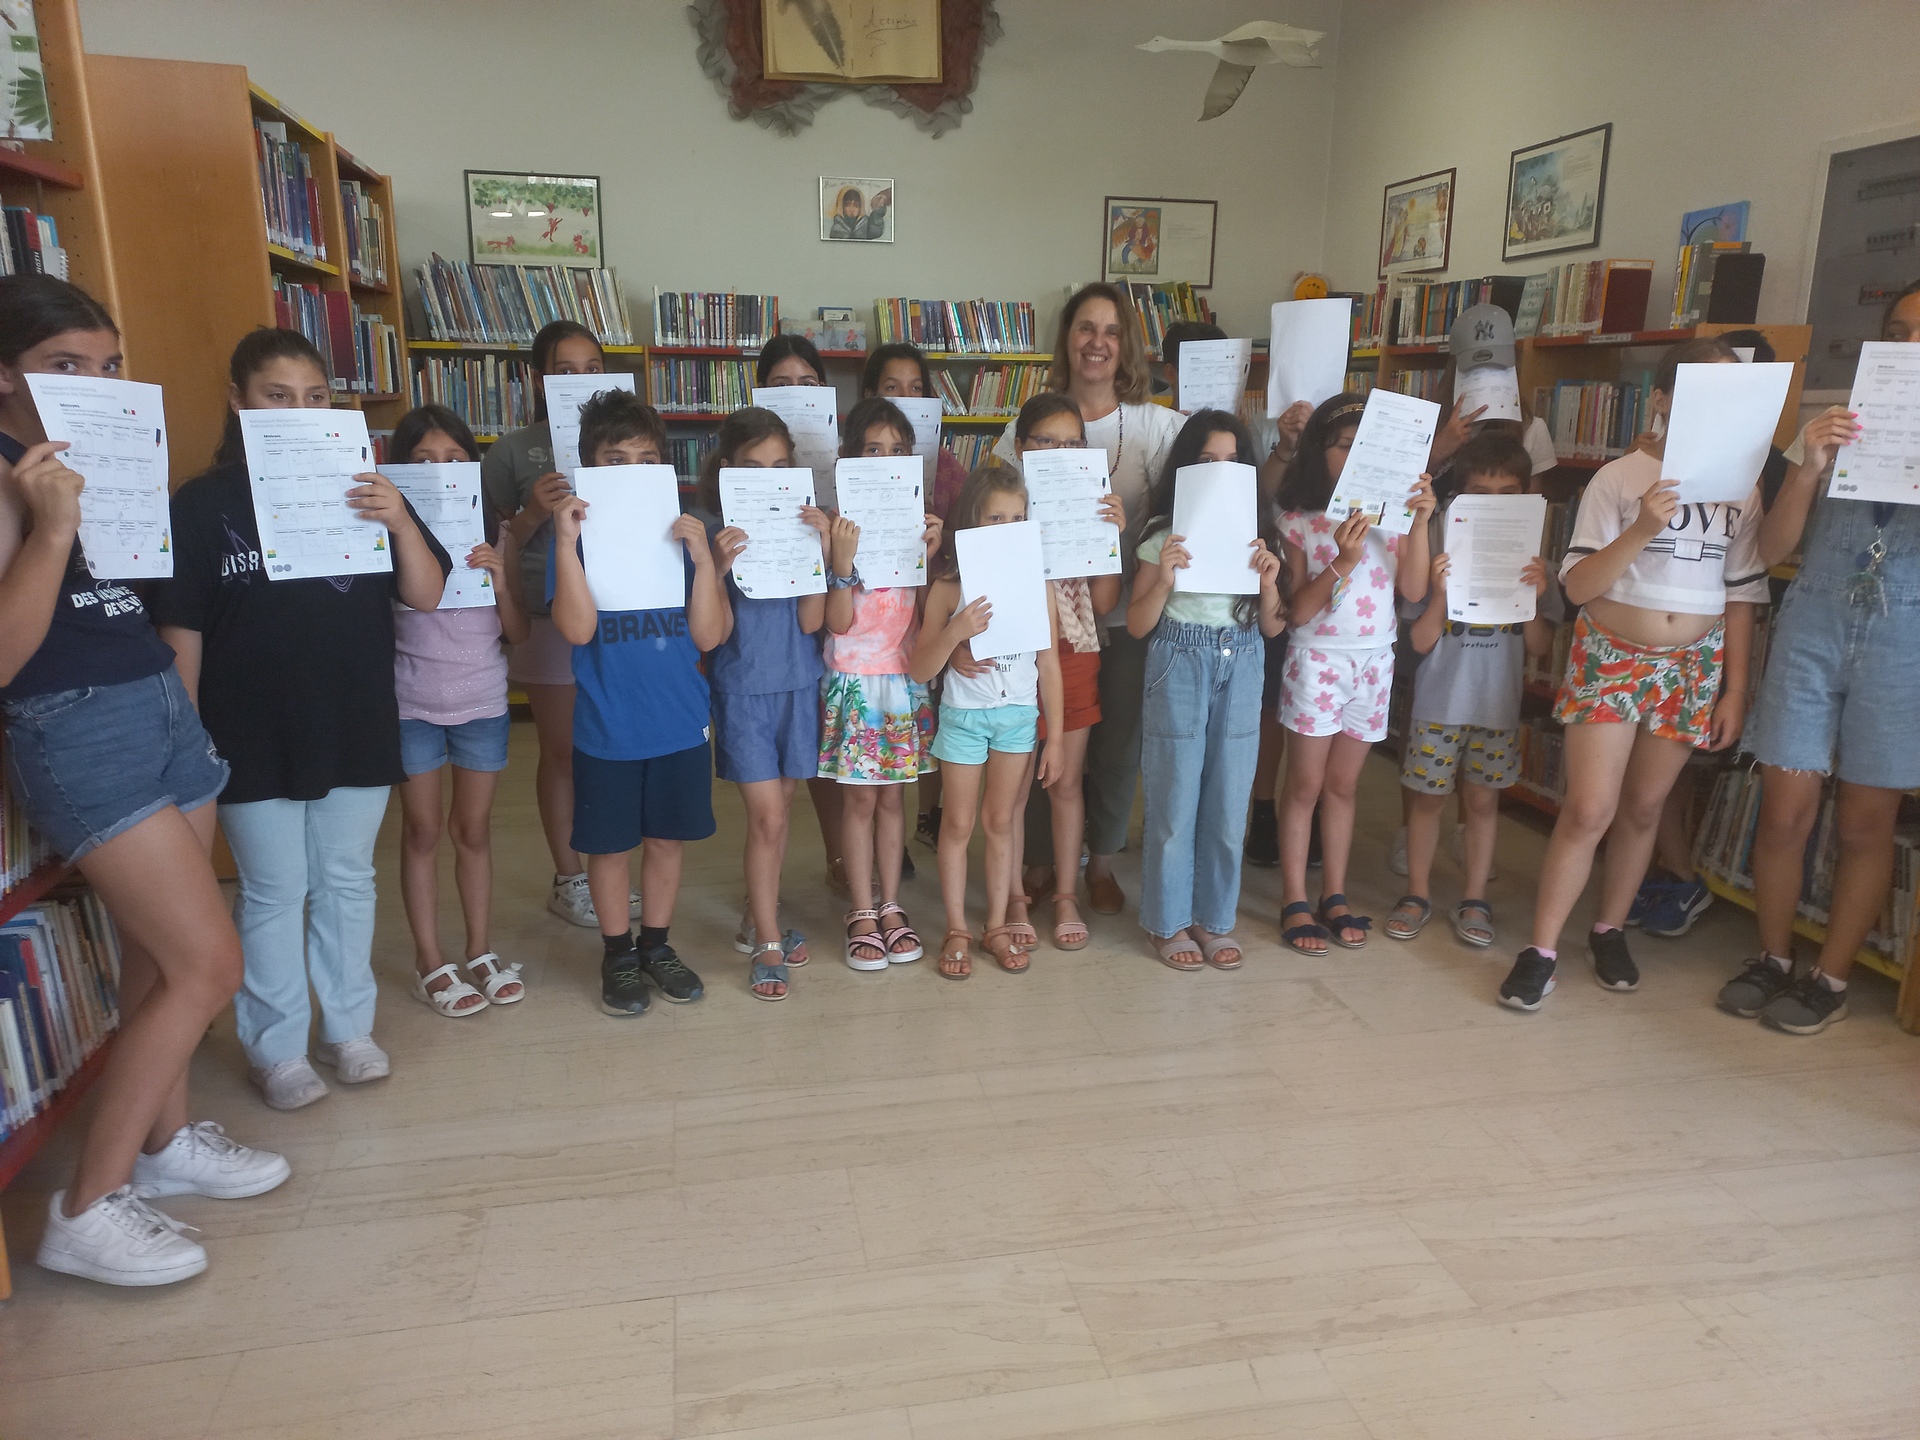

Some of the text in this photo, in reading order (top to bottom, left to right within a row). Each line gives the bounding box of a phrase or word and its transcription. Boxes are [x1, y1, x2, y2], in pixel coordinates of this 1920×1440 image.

[1667, 502, 1742, 539] OVE
[221, 550, 260, 577] DISR
[71, 591, 99, 609] DES
[600, 612, 686, 644] BRAVE
